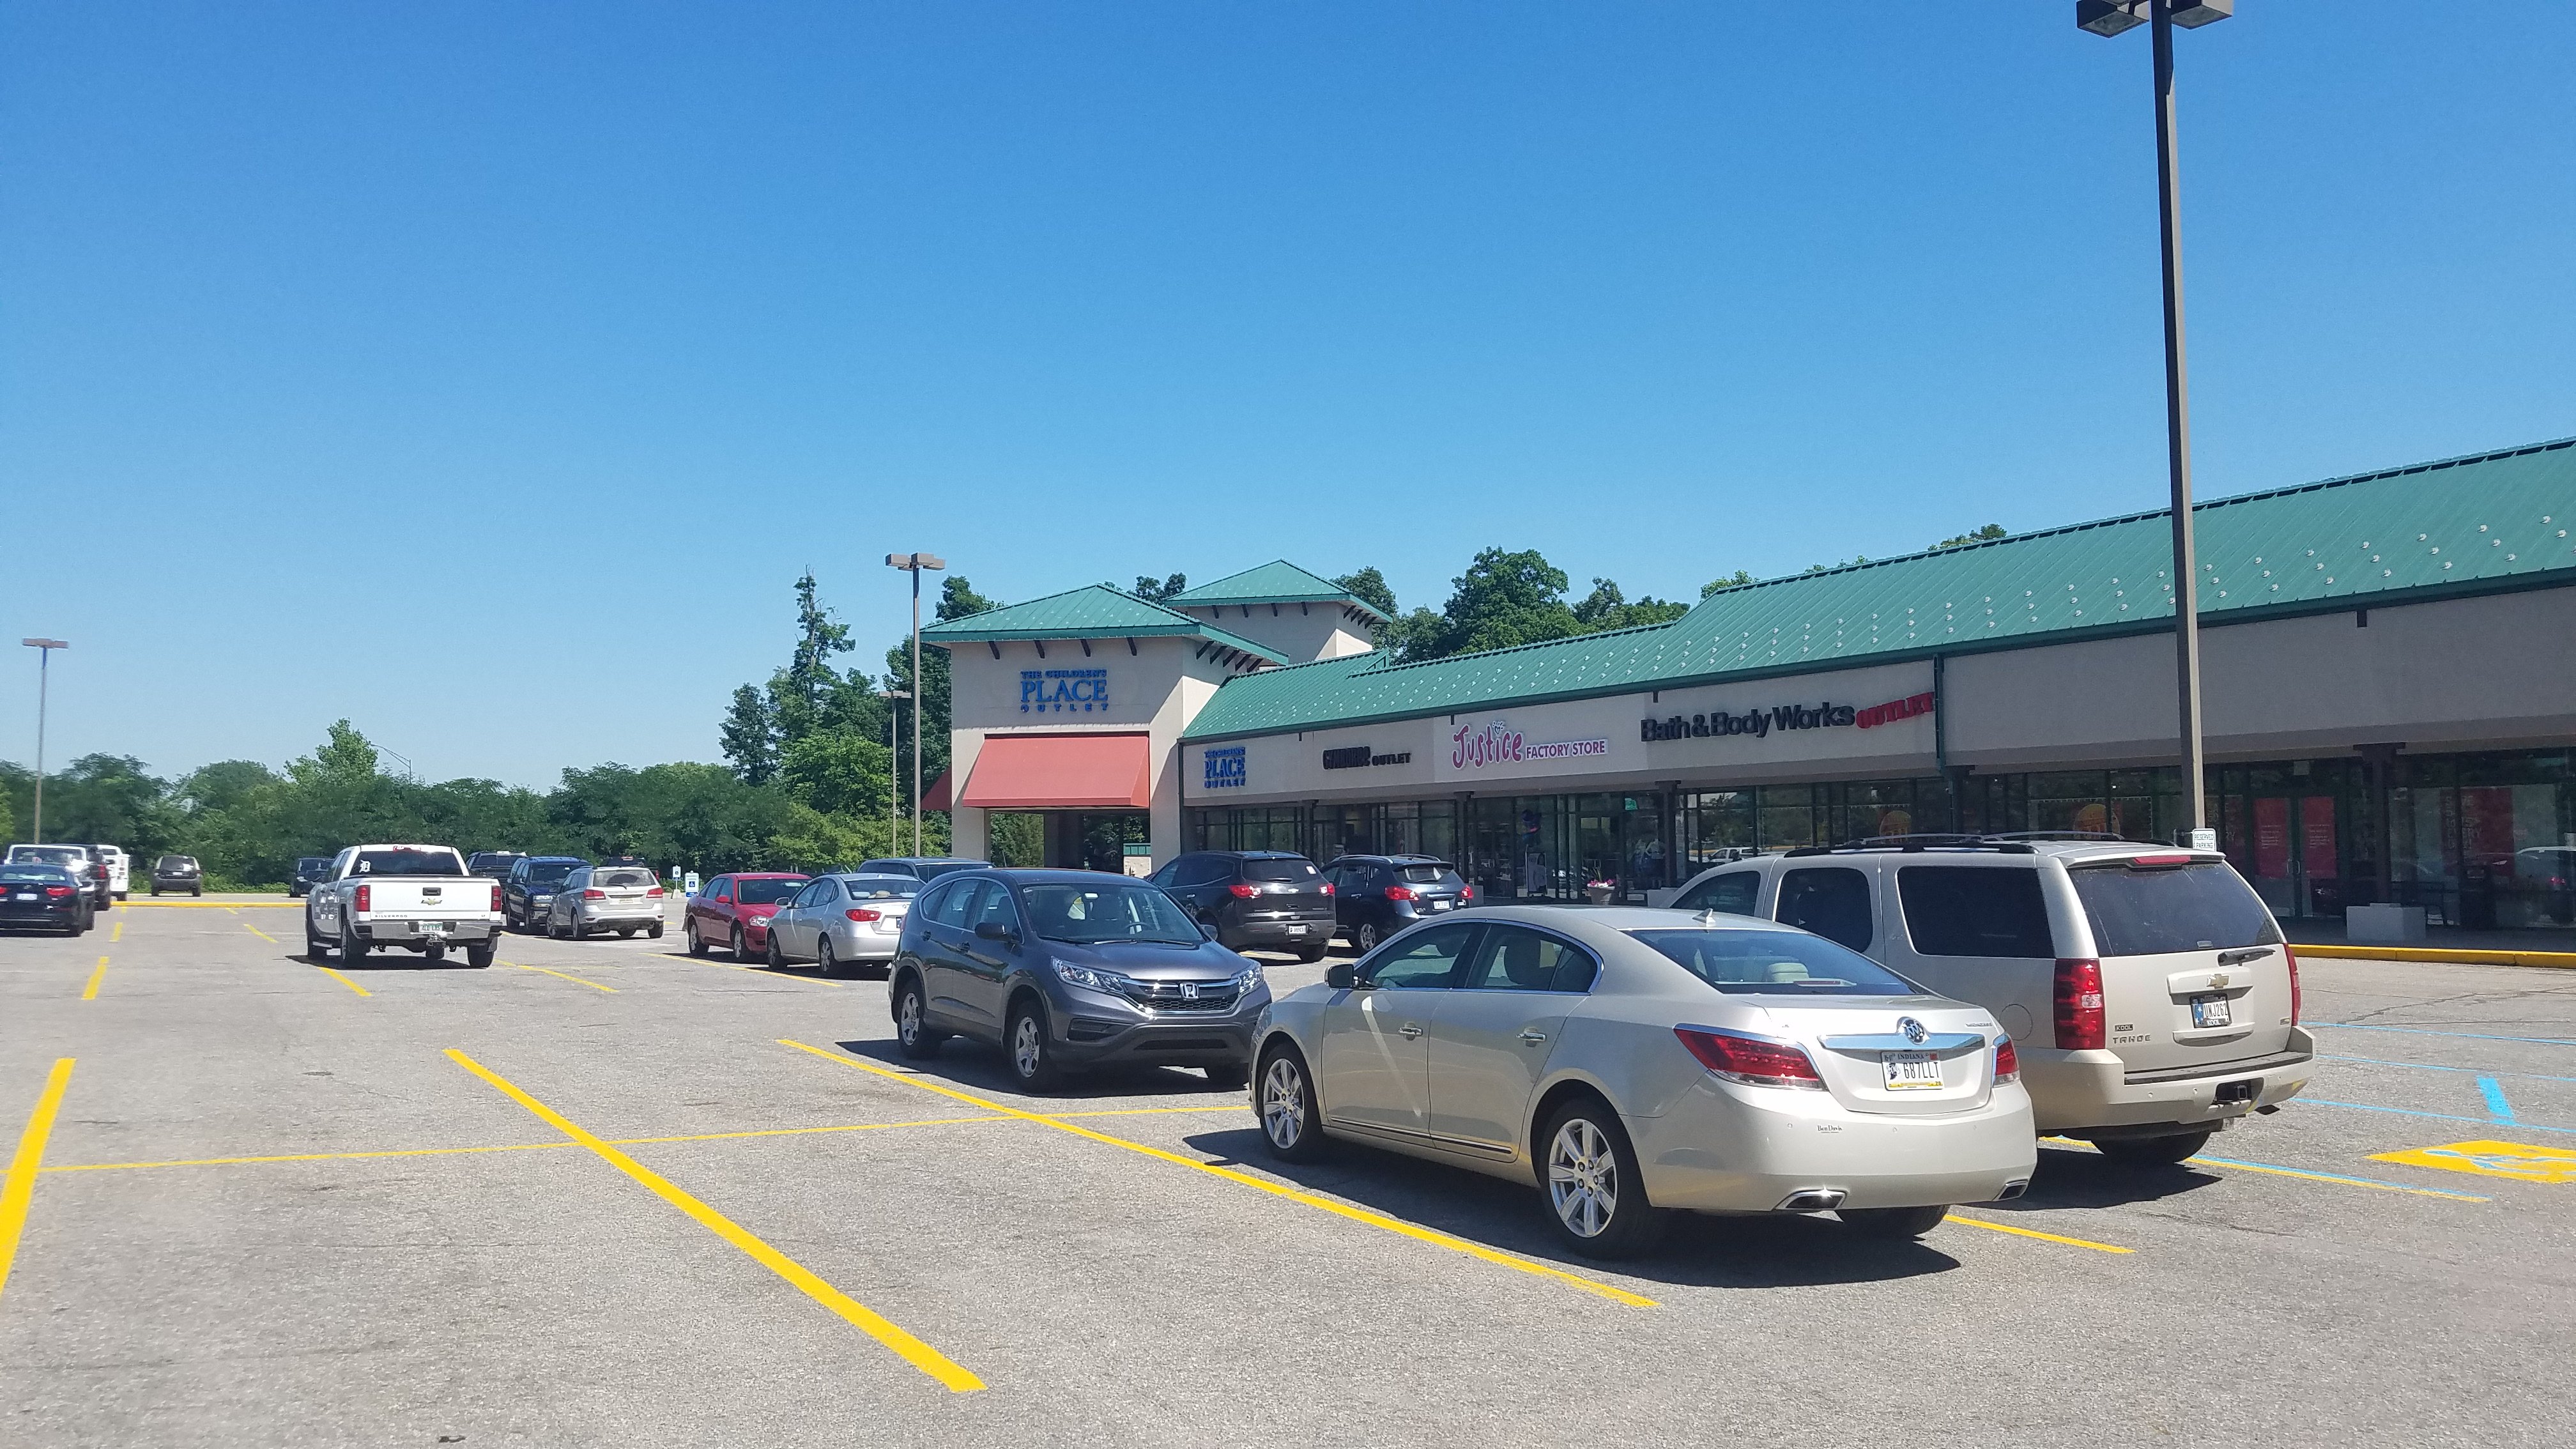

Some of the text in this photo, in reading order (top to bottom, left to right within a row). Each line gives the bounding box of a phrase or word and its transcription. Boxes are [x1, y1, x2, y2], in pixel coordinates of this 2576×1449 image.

[1020, 680, 1108, 702] PLACE
[1020, 703, 1108, 712] OUTLET
[1641, 716, 1690, 742] Bath
[1711, 709, 1772, 738] Body
[1772, 702, 1855, 730] Works
[1452, 723, 1606, 769] Justice FACTORY STORE
[1204, 757, 1246, 778] PLACE
[1372, 753, 1411, 766] OUTLET
[2113, 1035, 2151, 1044] TAHOE
[1903, 1061, 1940, 1079] 687LLT
